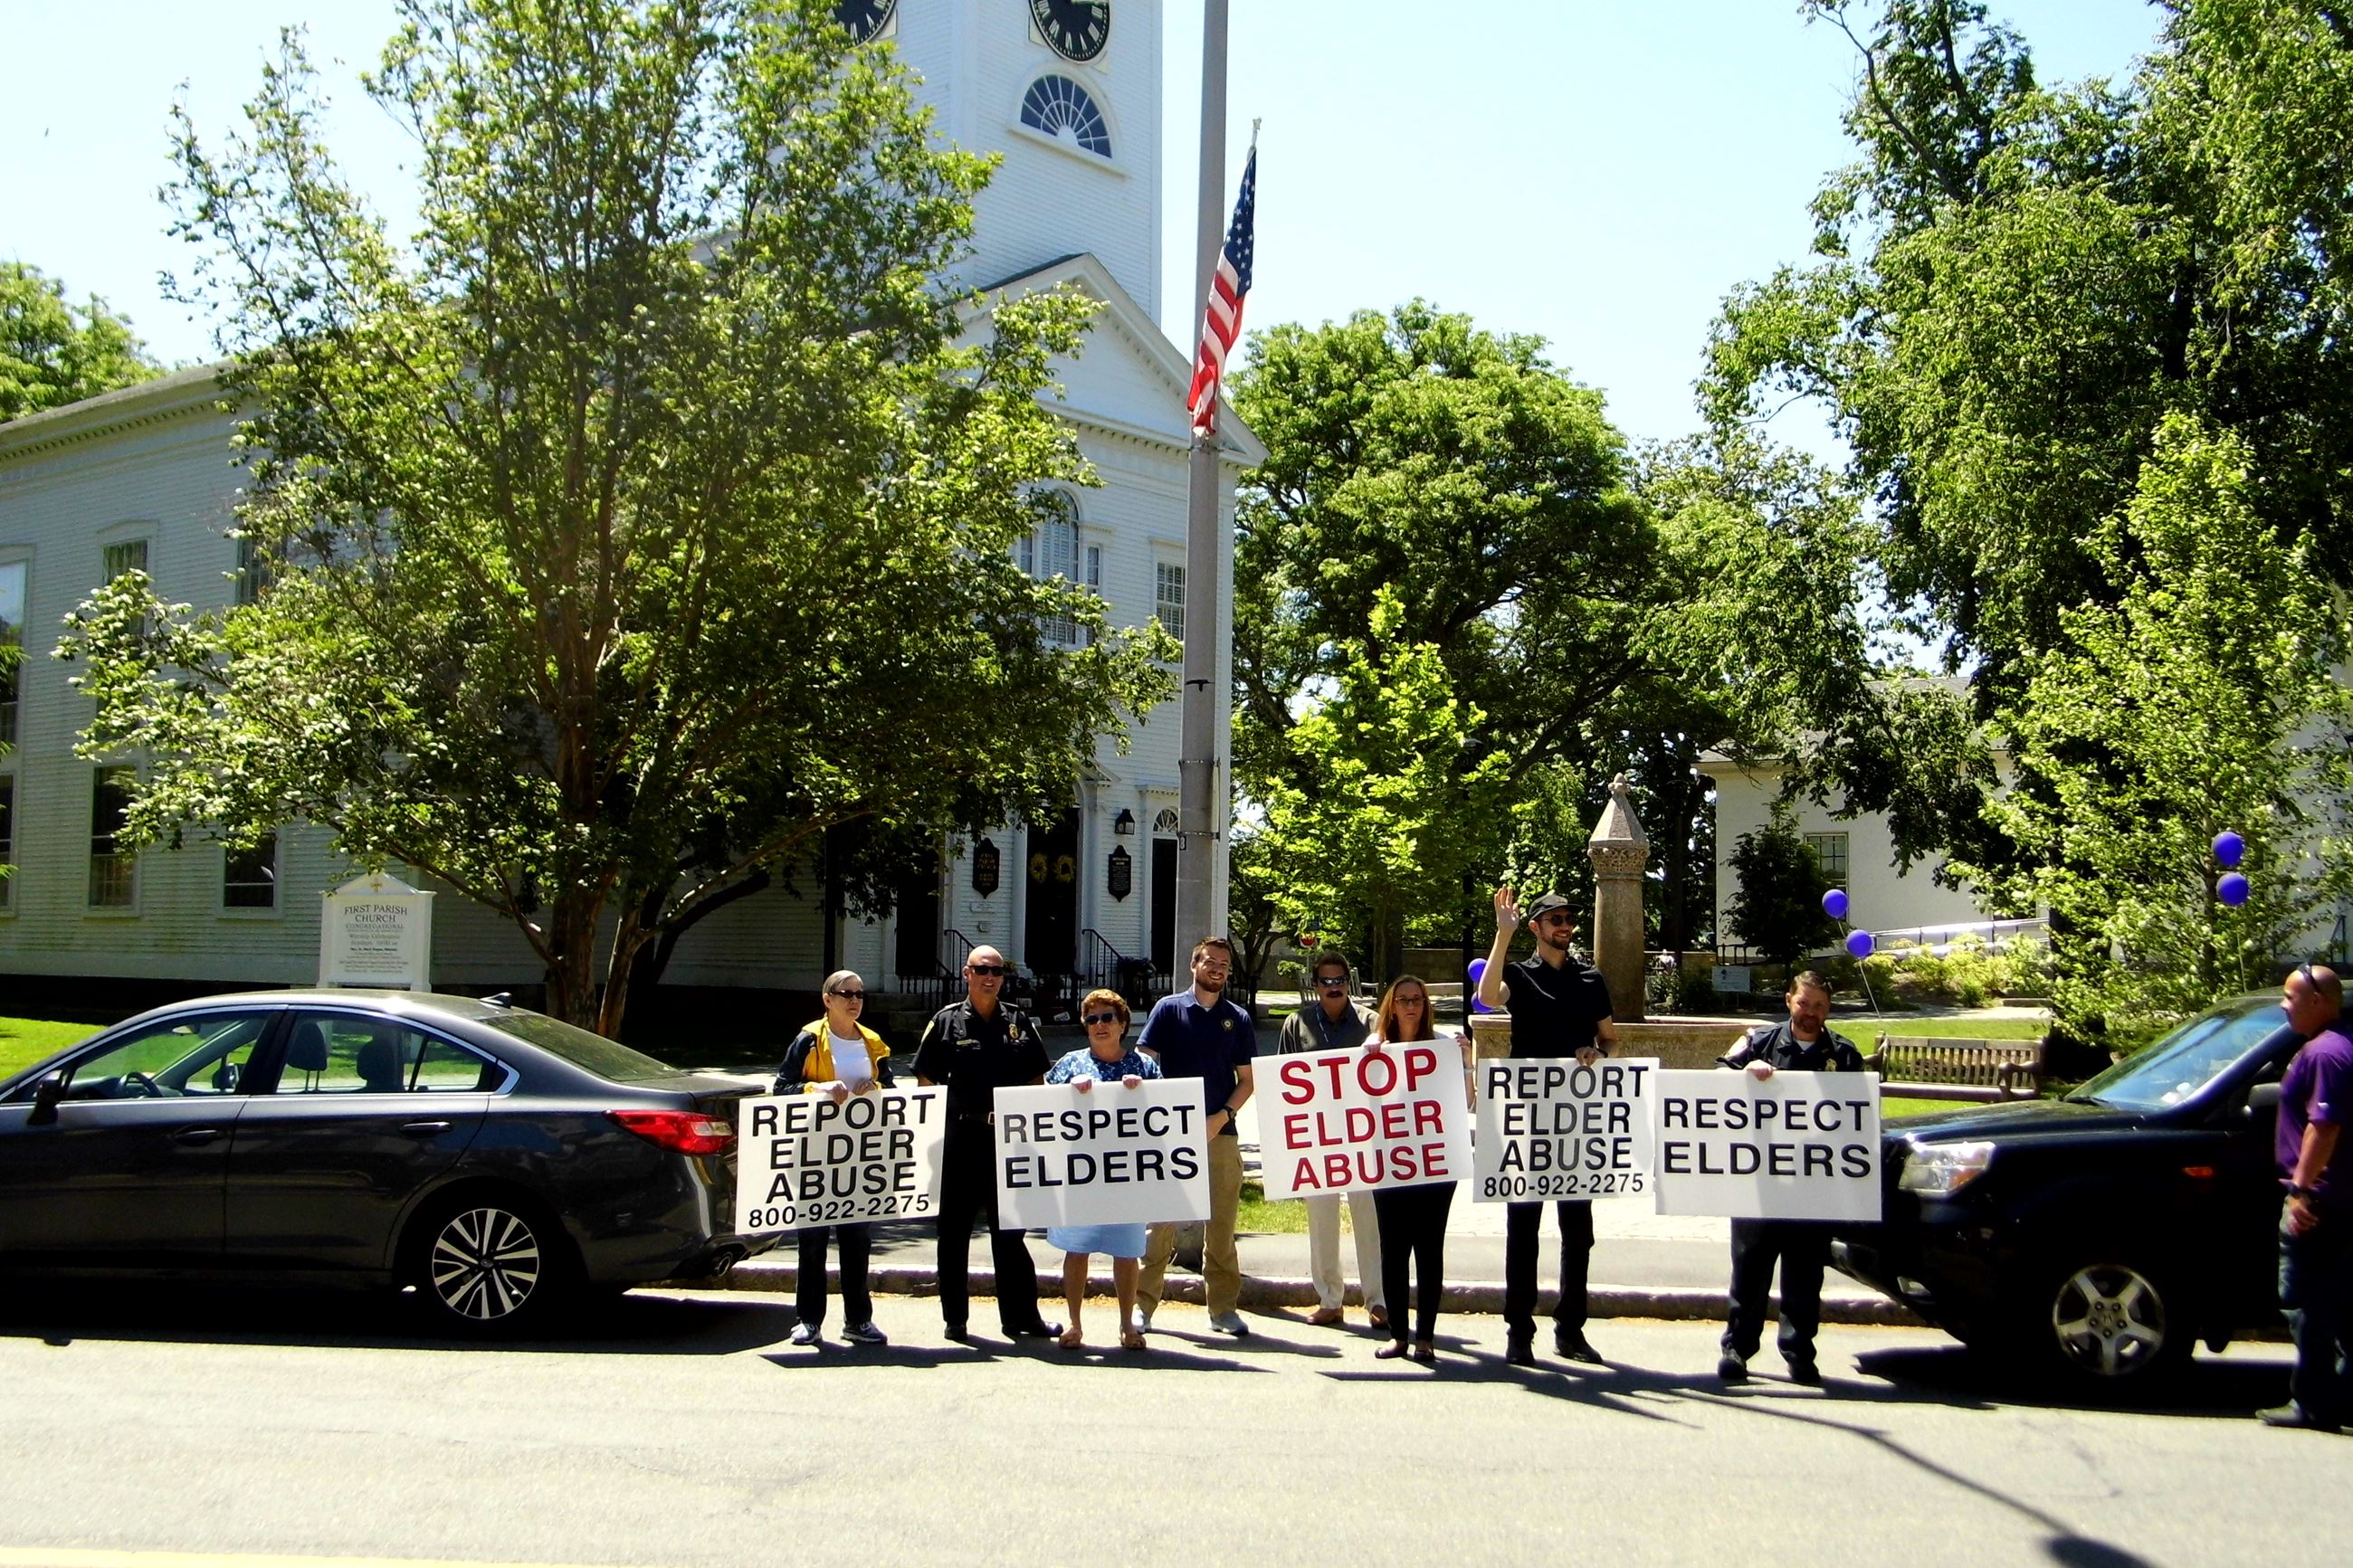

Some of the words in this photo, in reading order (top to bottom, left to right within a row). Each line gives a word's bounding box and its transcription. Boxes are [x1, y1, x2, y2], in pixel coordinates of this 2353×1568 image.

[345, 905, 370, 915] FIRST
[374, 906, 407, 915] PARISH
[355, 914, 395, 922] CHURCH
[1280, 1048, 1437, 1106] STOP
[1488, 1066, 1649, 1100] REPORT
[752, 1094, 936, 1137] REPORT
[1004, 1105, 1196, 1144] RESPECT
[1284, 1100, 1443, 1150] ELDER
[1503, 1101, 1631, 1136] ELDER
[1663, 1098, 1871, 1132] RESPECT
[770, 1128, 915, 1170] ELDER
[1005, 1146, 1199, 1189] ELDERS
[1292, 1143, 1449, 1192] ABUSE
[1498, 1136, 1633, 1173] ABUSE
[1663, 1141, 1872, 1179] ELDERS
[766, 1161, 917, 1204] ABUSE
[1483, 1173, 1643, 1198] 800-922-2275
[748, 1193, 929, 1228] 800-922-2275
